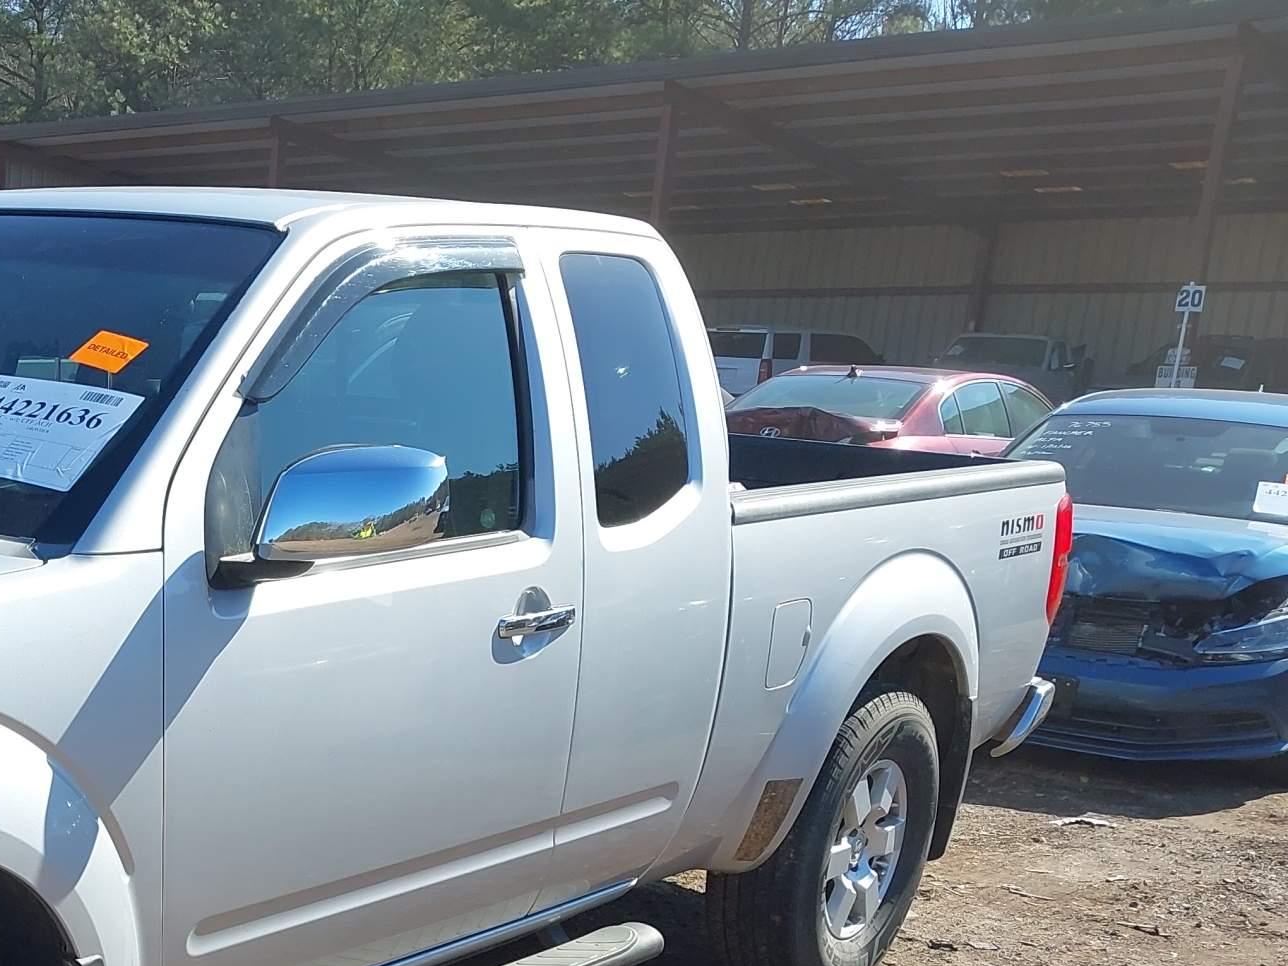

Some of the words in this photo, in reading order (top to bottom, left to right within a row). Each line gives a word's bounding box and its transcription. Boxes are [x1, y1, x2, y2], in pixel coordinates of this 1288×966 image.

[1177, 289, 1203, 308] 20
[87, 342, 129, 361] DETAILED
[1158, 367, 1197, 378] BUIDING
[1003, 547, 1017, 557] OFF
[1019, 543, 1038, 555] ROAD
